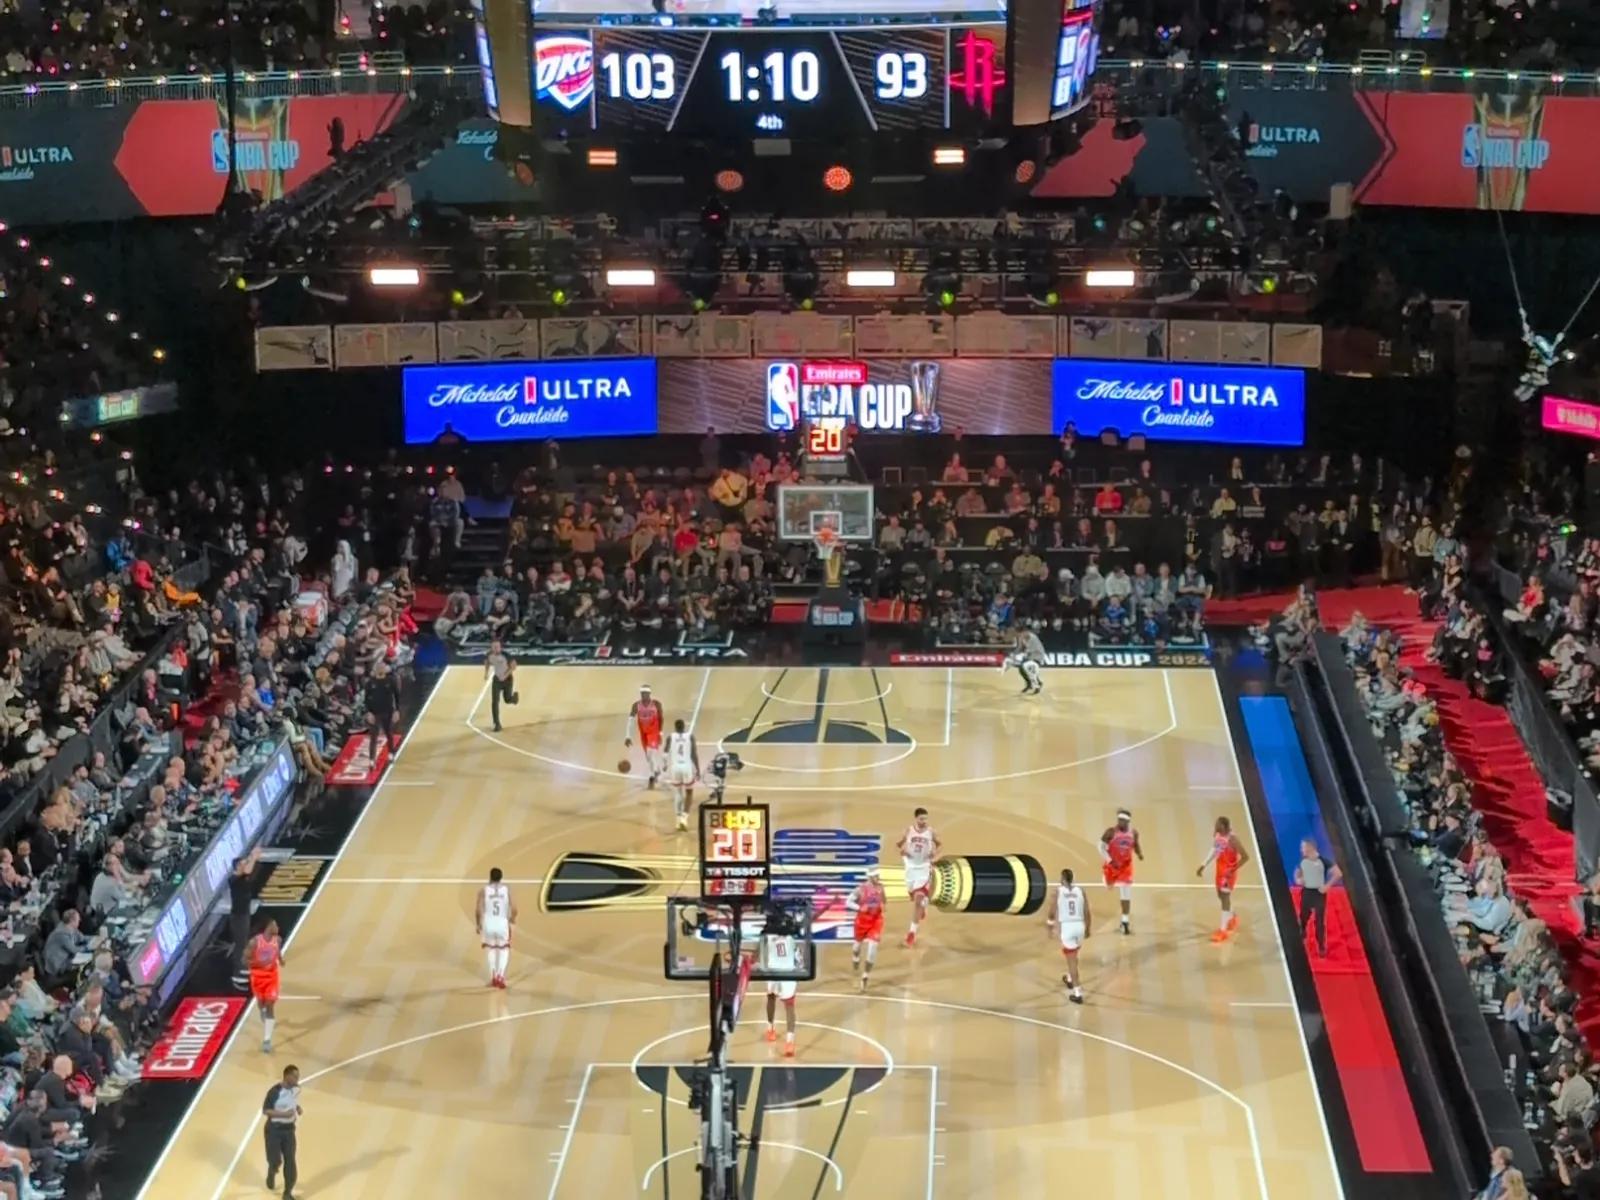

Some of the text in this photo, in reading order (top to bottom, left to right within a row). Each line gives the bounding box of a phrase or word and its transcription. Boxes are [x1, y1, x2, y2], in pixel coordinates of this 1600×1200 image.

[537, 51, 592, 90] OKC
[602, 53, 675, 99] 103
[721, 52, 819, 101] 1:10
[877, 53, 927, 98] 93
[757, 114, 783, 129] 4th
[1261, 127, 1320, 143] ULTRA
[15, 146, 73, 164] ULTRA
[806, 365, 862, 381] Emirates
[429, 377, 631, 407] Michelob ULTRA
[1077, 379, 1279, 407] Michelob ULTRA
[496, 405, 569, 428] Courtside
[859, 384, 912, 429] CUP
[1142, 405, 1214, 428] Courtside
[811, 429, 841, 453] 20
[622, 647, 748, 657] ULTRA
[1095, 652, 1151, 666] CUP
[712, 829, 758, 861] 20
[722, 867, 766, 877] TISSOT
[492, 901, 500, 916] 5
[150, 1001, 229, 1072] Emirates
